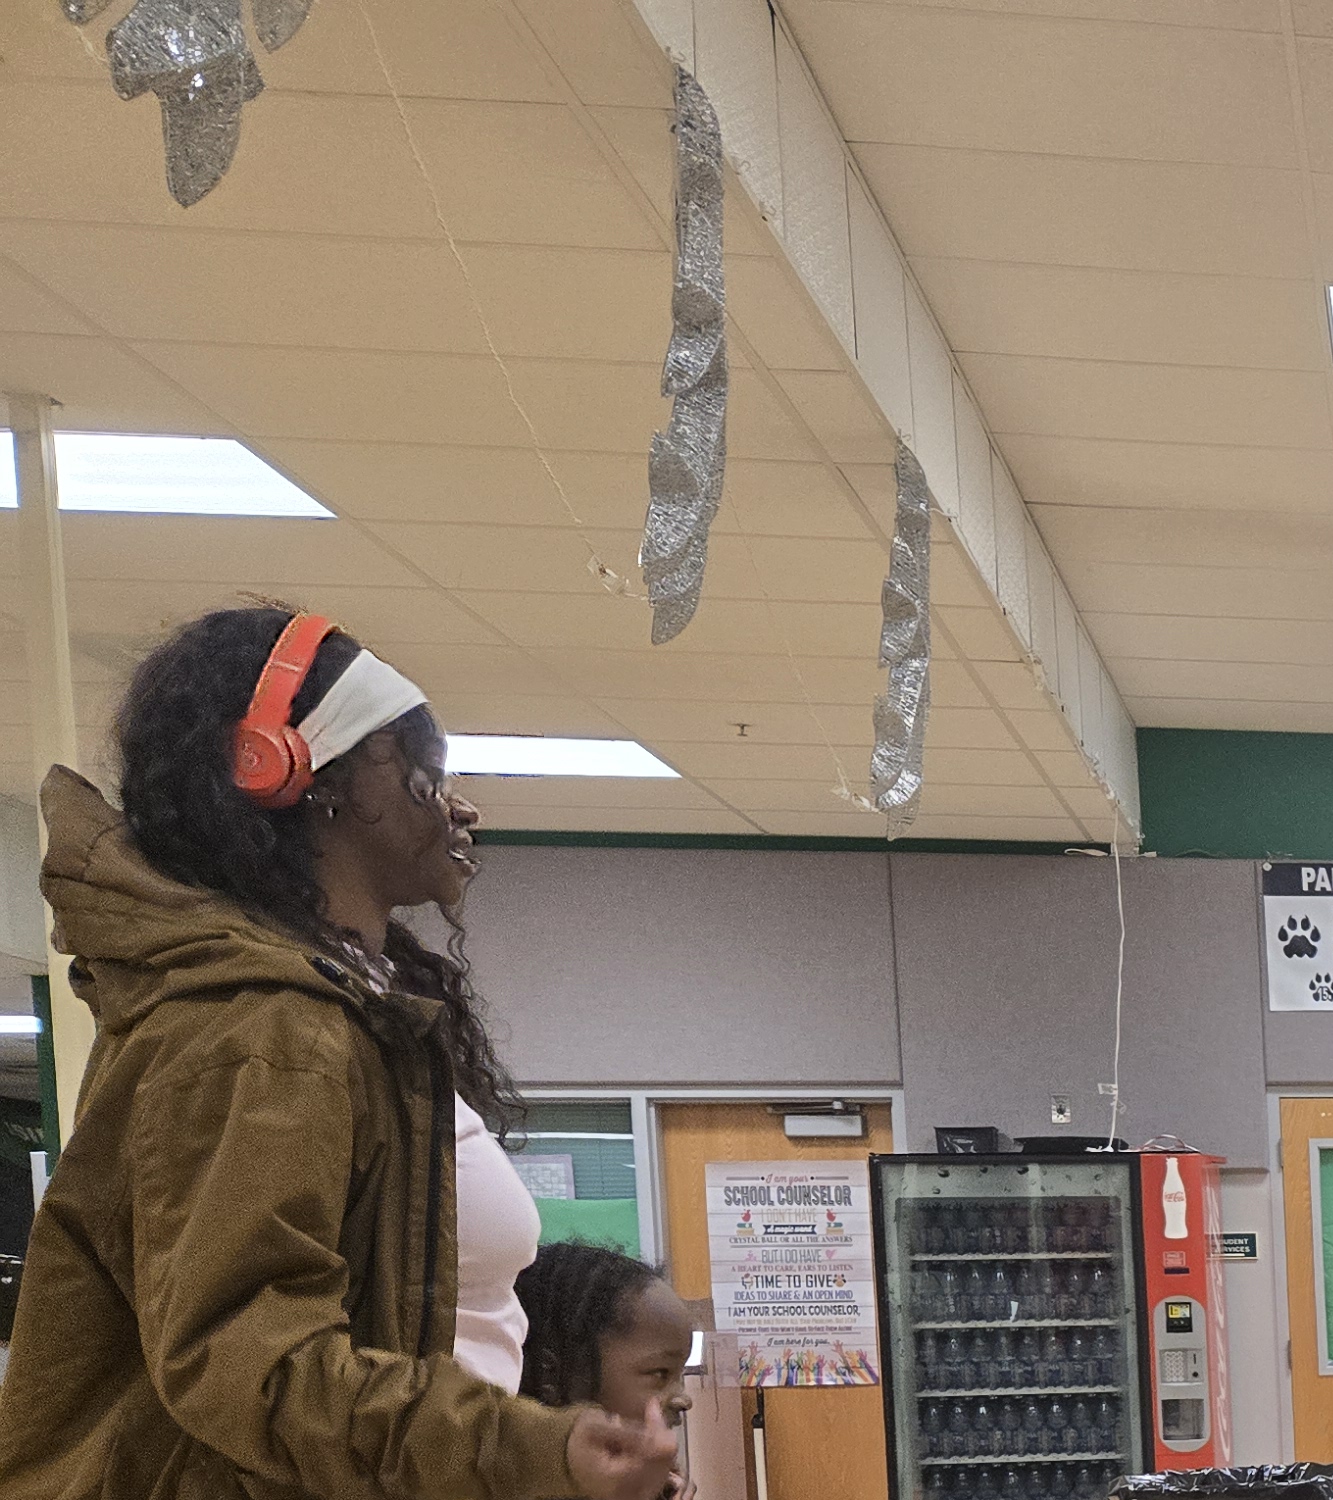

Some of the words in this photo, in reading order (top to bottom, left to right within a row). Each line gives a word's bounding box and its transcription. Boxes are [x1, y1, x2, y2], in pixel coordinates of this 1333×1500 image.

[724, 1185, 776, 1207] SCHOOL
[776, 1184, 853, 1207] COUNSELOR
[753, 1274, 783, 1289] TIME
[785, 1274, 802, 1289] TO
[804, 1273, 833, 1289] GIVE
[734, 1290, 756, 1301] IDEAS
[756, 1290, 767, 1301] TO
[768, 1290, 792, 1301] SHARE
[814, 1290, 834, 1300] OPEN
[835, 1289, 854, 1300] MIND
[733, 1306, 746, 1317] AM
[746, 1305, 770, 1317] YOUR
[771, 1305, 807, 1317] SCHOOL
